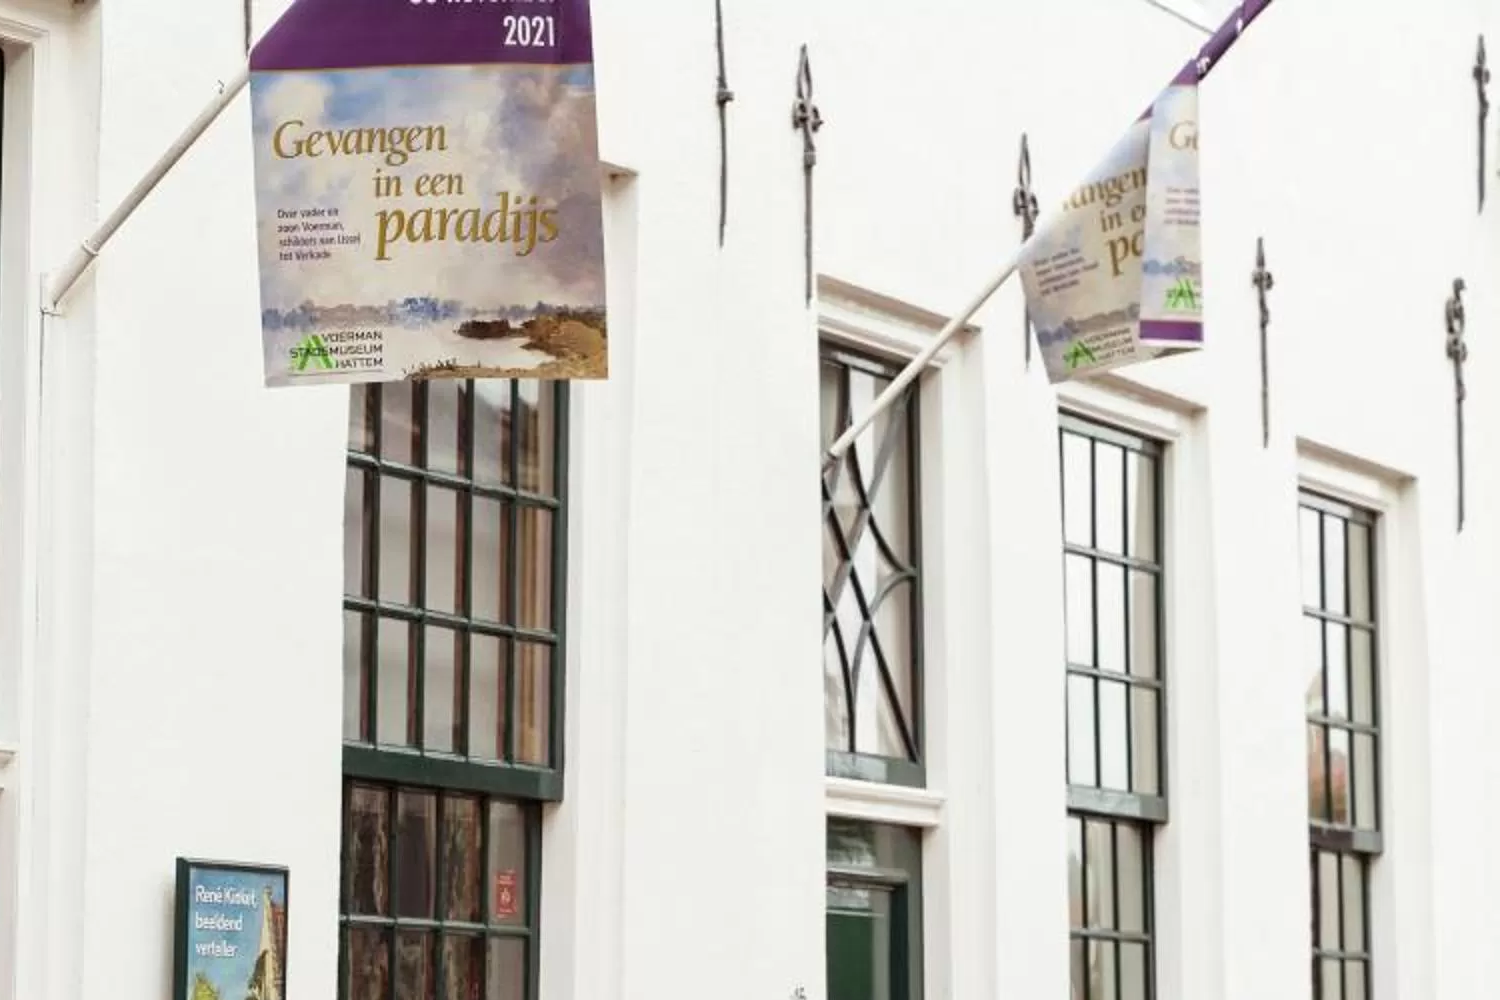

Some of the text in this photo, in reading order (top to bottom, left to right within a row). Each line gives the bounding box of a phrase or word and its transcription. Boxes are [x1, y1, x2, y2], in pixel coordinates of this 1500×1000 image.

[503, 15, 555, 47] 2021
[273, 119, 449, 166] Gevangen
[372, 167, 465, 198] in een
[373, 191, 560, 261] paradijs
[320, 331, 383, 343] VOERMAN
[335, 357, 383, 369] HATTEM
